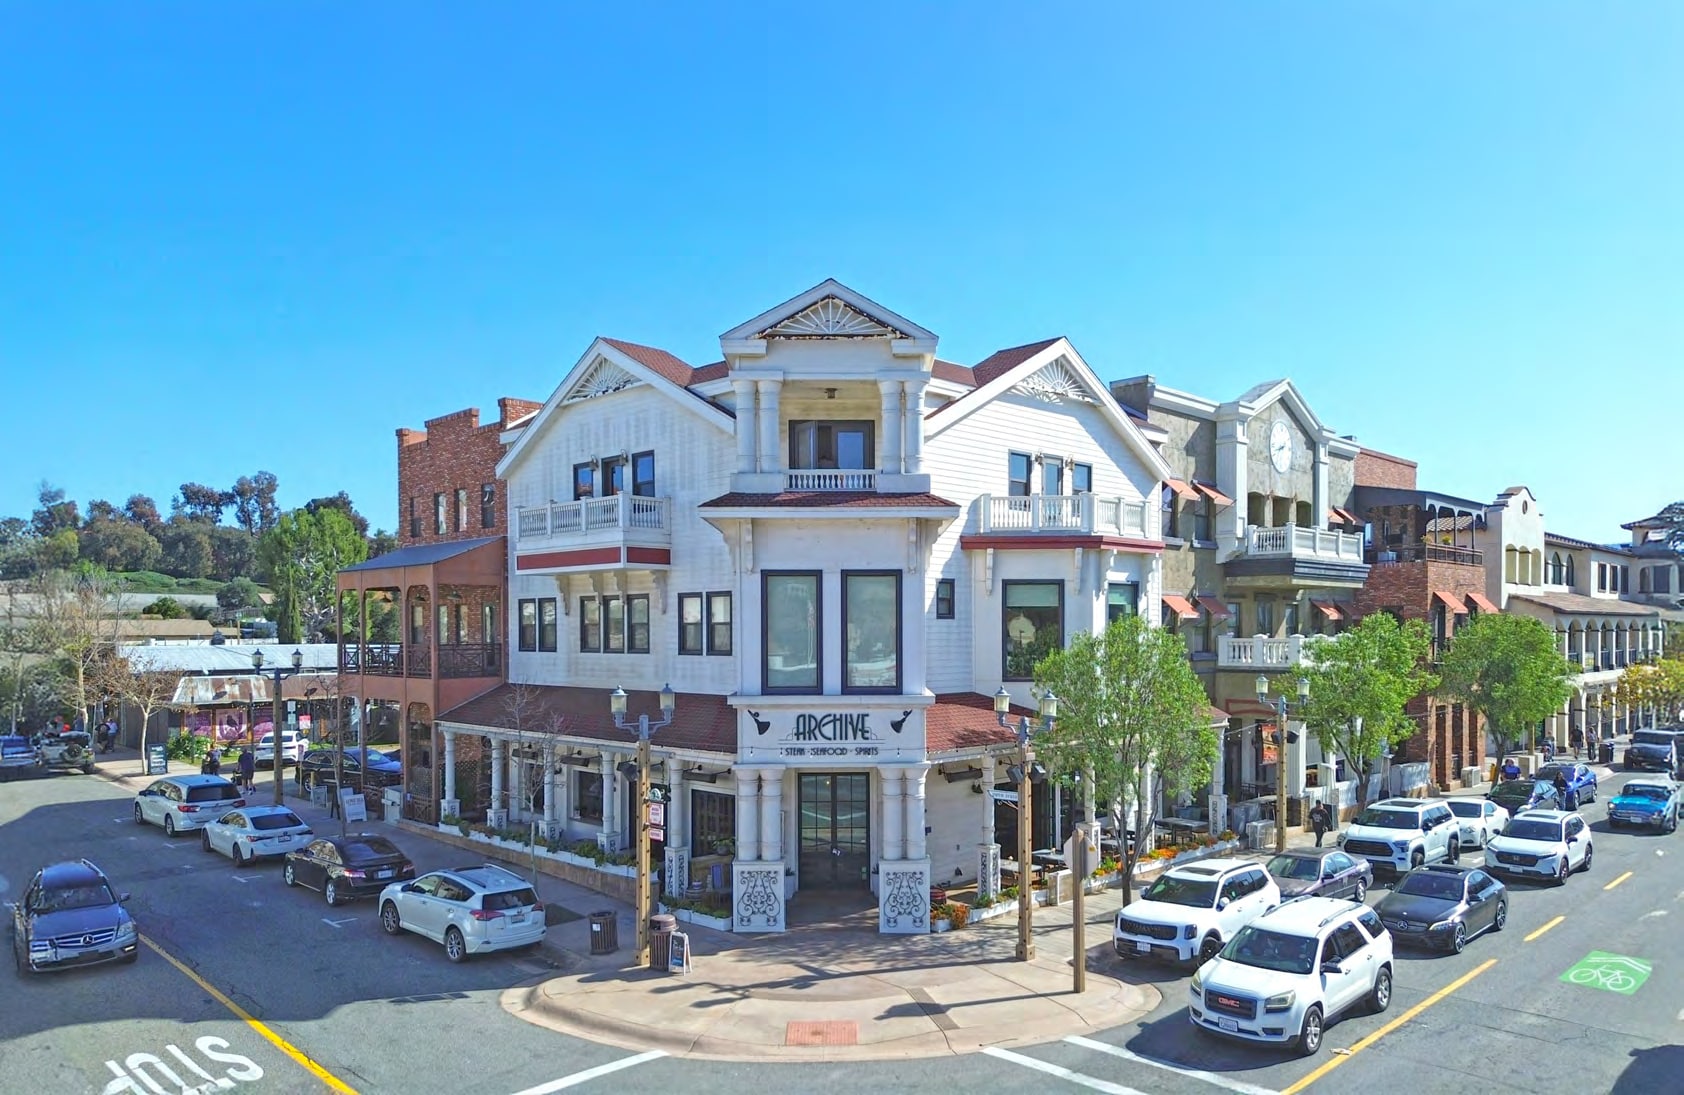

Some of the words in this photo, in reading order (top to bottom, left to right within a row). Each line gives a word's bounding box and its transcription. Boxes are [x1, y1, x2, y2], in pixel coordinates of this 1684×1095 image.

[794, 713, 870, 741] ARCHIVE
[785, 747, 806, 756] STEAK
[812, 747, 848, 756] SEAFOOD
[855, 747, 879, 756] SPIRITS
[1218, 996, 1240, 1008] GMC
